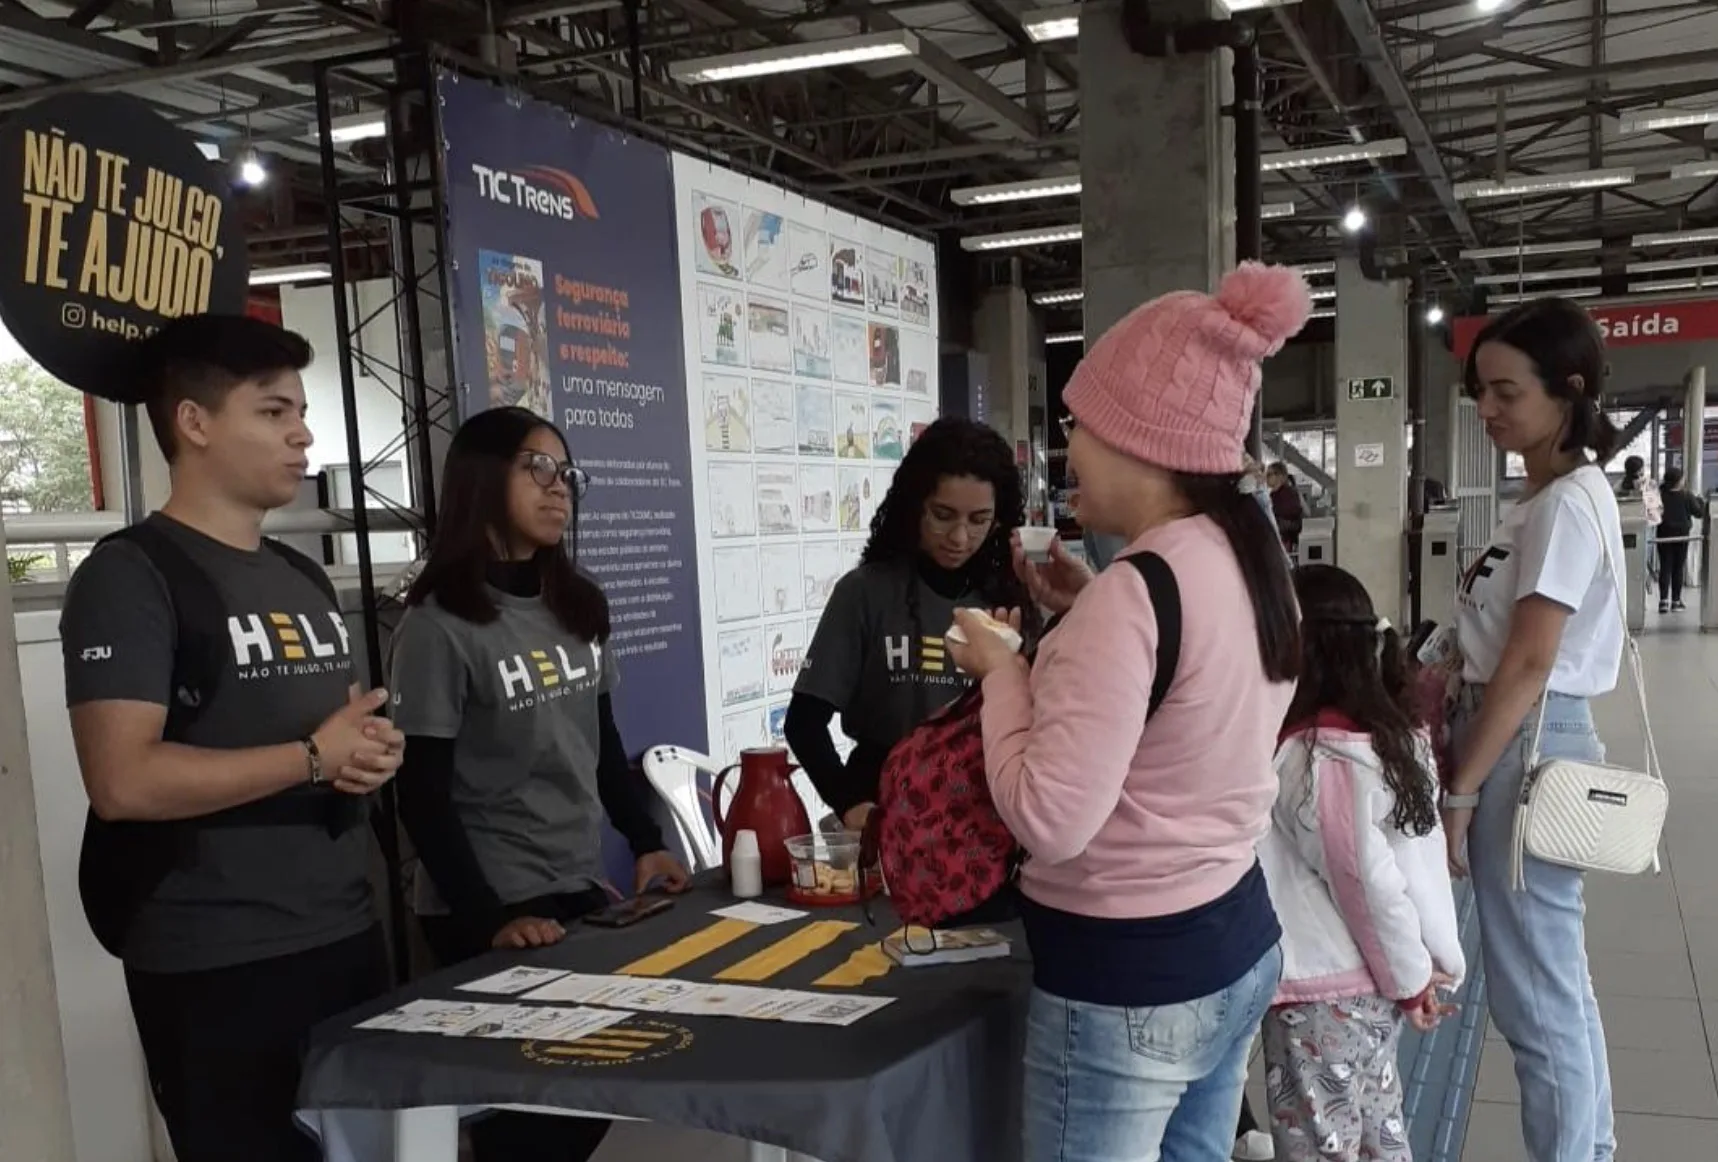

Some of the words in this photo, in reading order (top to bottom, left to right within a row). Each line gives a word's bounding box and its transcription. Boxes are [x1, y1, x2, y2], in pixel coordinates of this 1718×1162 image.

[23, 127, 87, 203] NÃO
[96, 149, 130, 216] TE
[134, 167, 224, 260] JULGO,
[472, 163, 511, 205] TIC
[23, 192, 74, 289] TE
[79, 209, 213, 319] AJUDO
[1595, 312, 1679, 338] Saída
[562, 375, 594, 395] uma
[596, 379, 665, 407] mensagem
[564, 408, 597, 430] para
